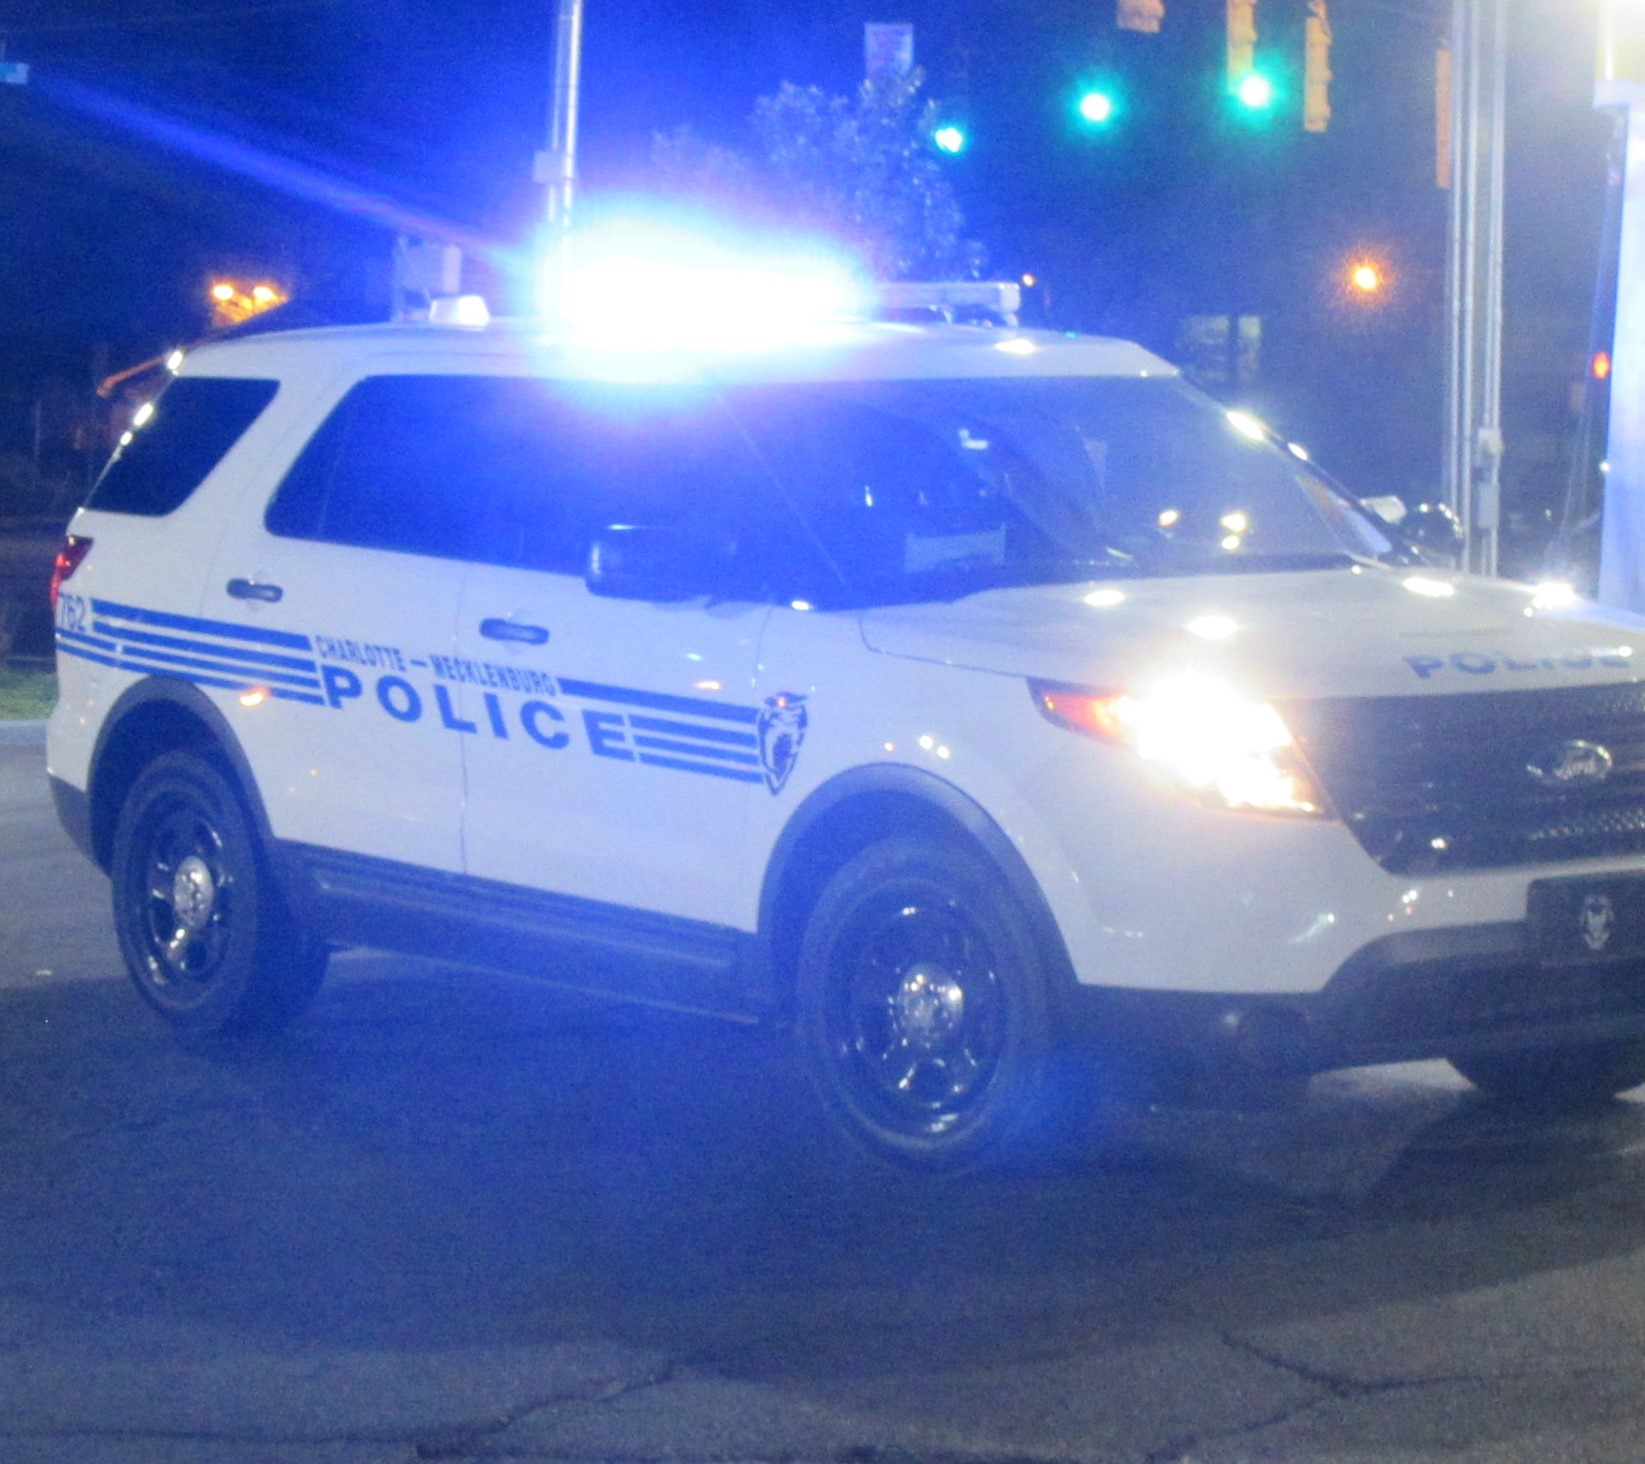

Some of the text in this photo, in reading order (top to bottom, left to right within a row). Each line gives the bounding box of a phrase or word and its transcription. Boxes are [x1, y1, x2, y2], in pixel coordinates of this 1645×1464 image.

[316, 635, 406, 672] CHARLOTTE
[430, 653, 556, 697] MECKLENBURG
[321, 664, 635, 762] POLICE
